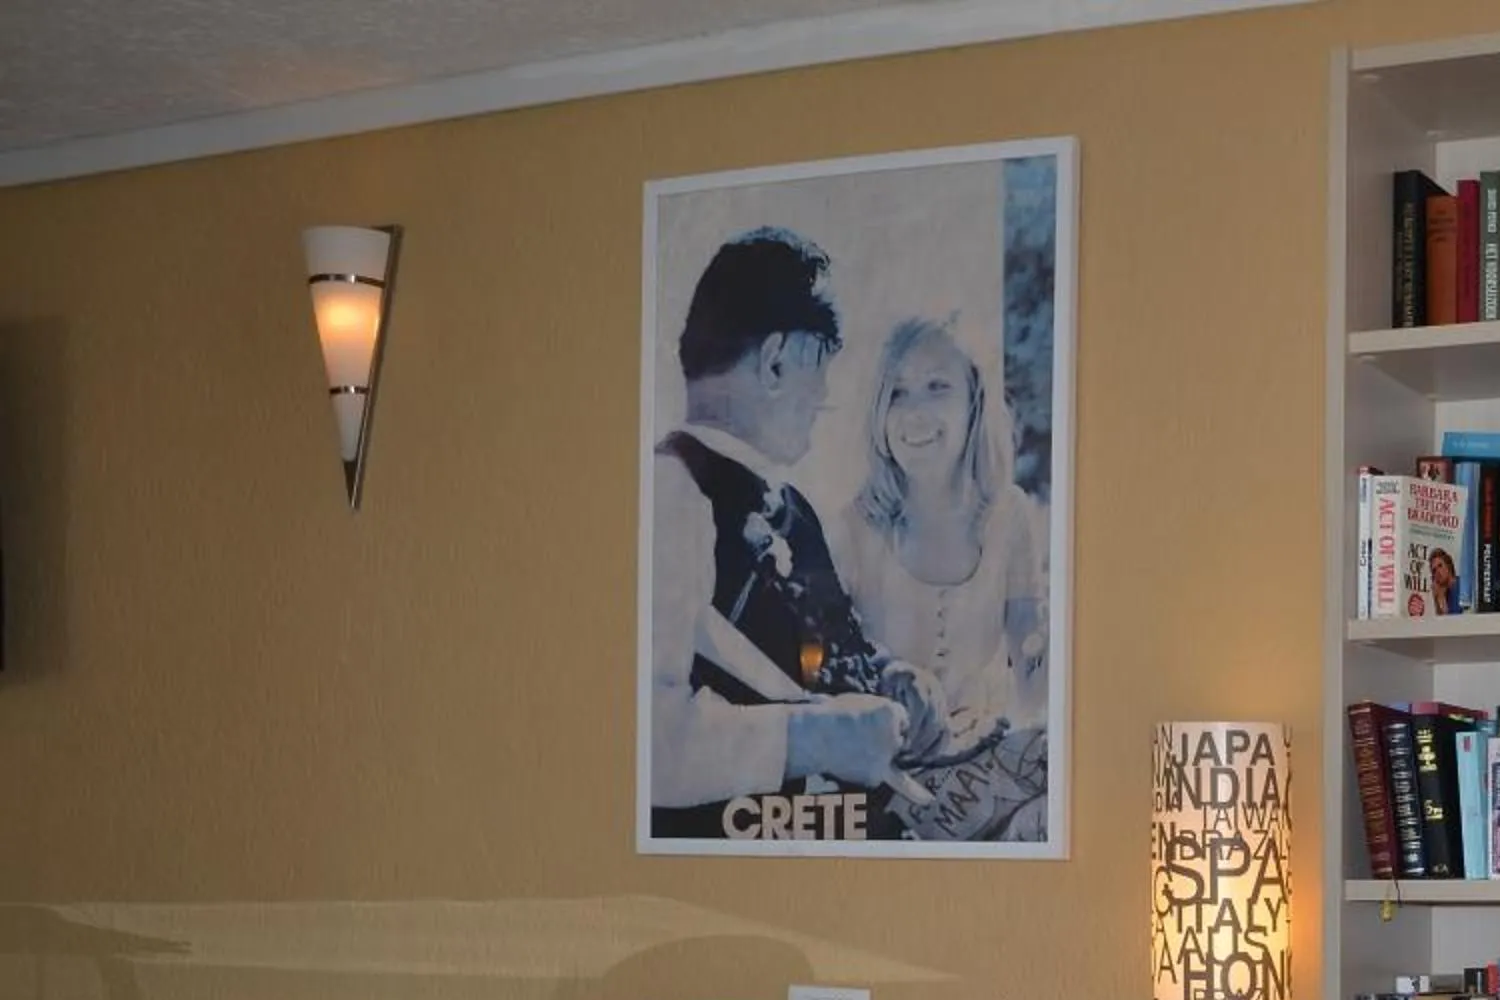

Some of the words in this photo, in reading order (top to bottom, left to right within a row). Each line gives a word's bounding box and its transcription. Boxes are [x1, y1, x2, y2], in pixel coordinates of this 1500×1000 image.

[1378, 498, 1396, 529] ACT
[1378, 536, 1396, 560] OF
[1408, 543, 1429, 561] ACT
[1377, 563, 1396, 608] WILL
[1166, 767, 1281, 811] INDIA
[722, 793, 867, 840] CRETE
